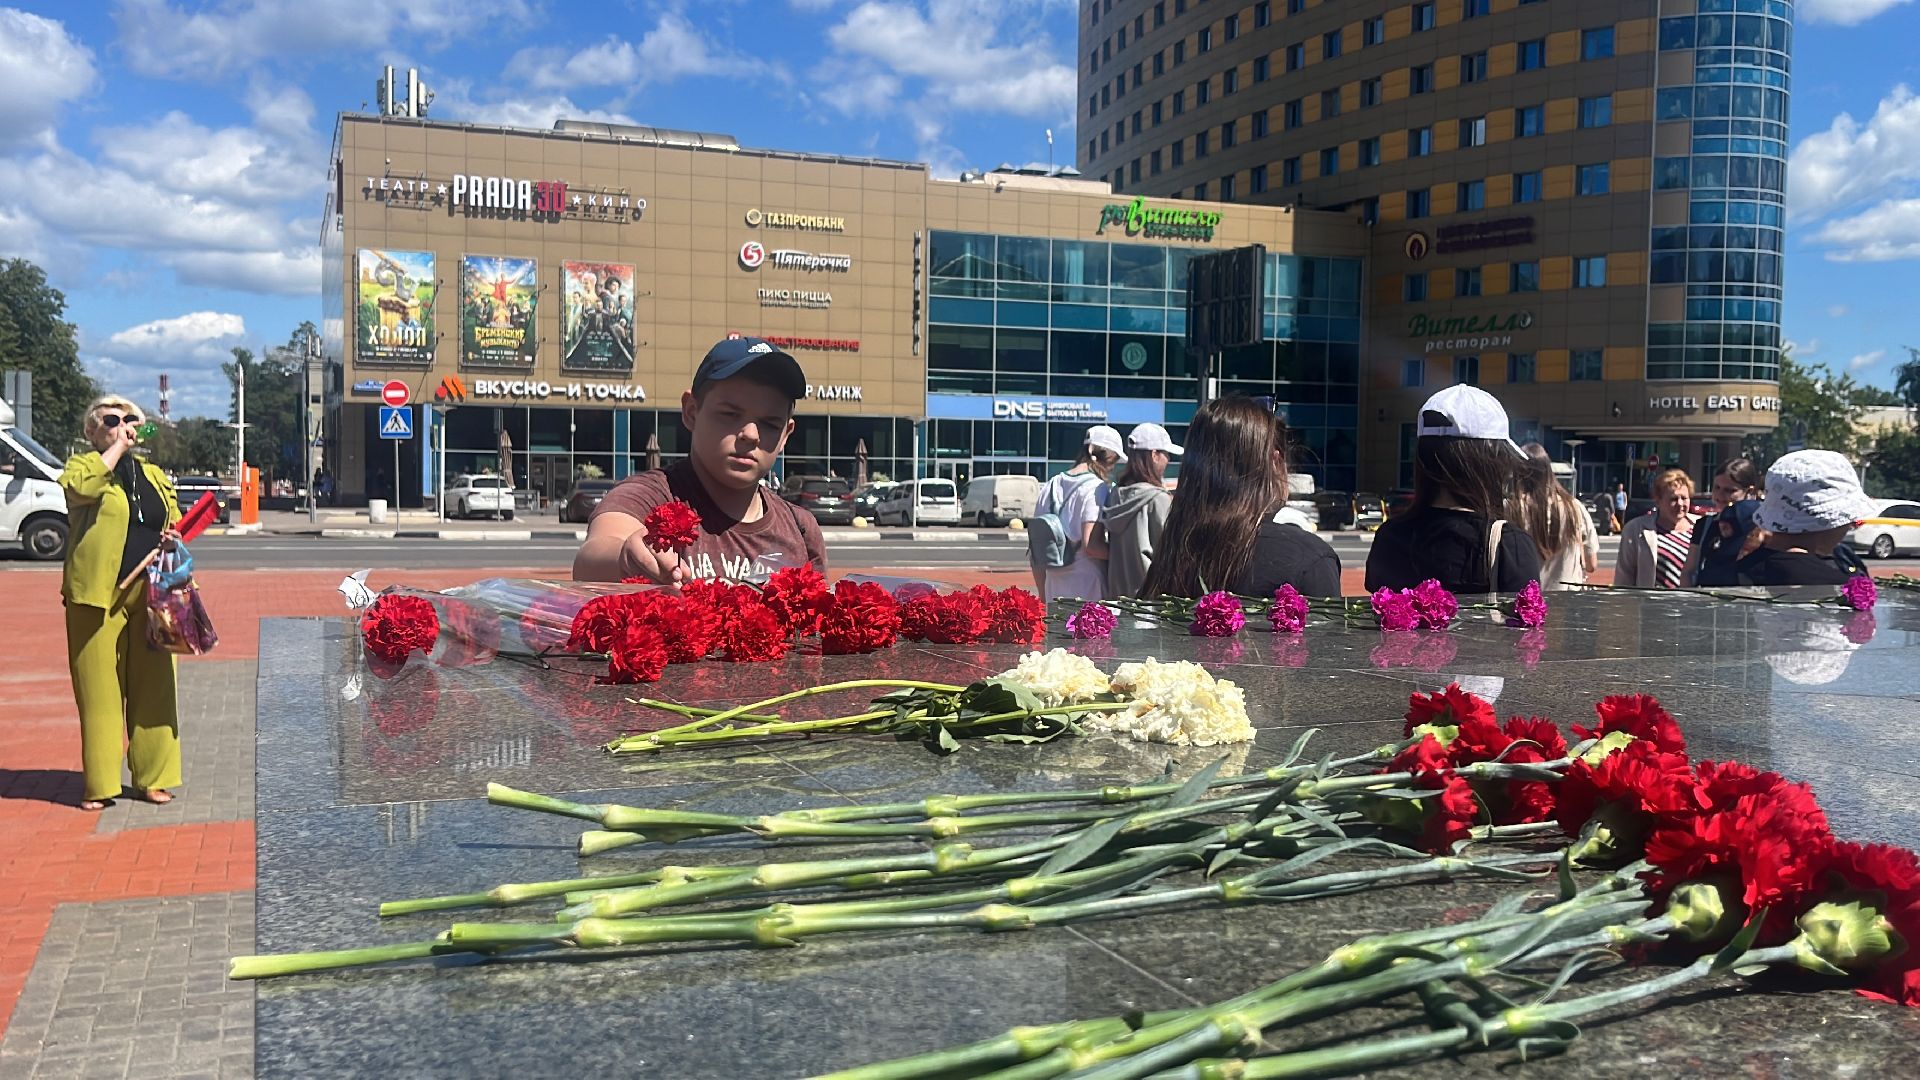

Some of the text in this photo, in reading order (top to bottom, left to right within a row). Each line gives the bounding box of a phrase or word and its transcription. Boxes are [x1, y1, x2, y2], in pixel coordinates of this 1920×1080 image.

[367, 177, 429, 192] ТЕАТР
[453, 174, 531, 211] PRADA
[588, 195, 647, 210] КИНО
[767, 211, 846, 231] ГАЗПРОМБАНК
[758, 288, 833, 302] ПИКО ПИЦЦА
[1425, 335, 1512, 353] ресторан
[475, 380, 550, 396] ВКУСНО
[585, 384, 646, 399] ТОЧКА
[817, 384, 862, 400] ЛАУНЖ
[994, 400, 1044, 417] DNS
[1650, 396, 1699, 409] HOTEL
[1707, 394, 1747, 409] EAST
